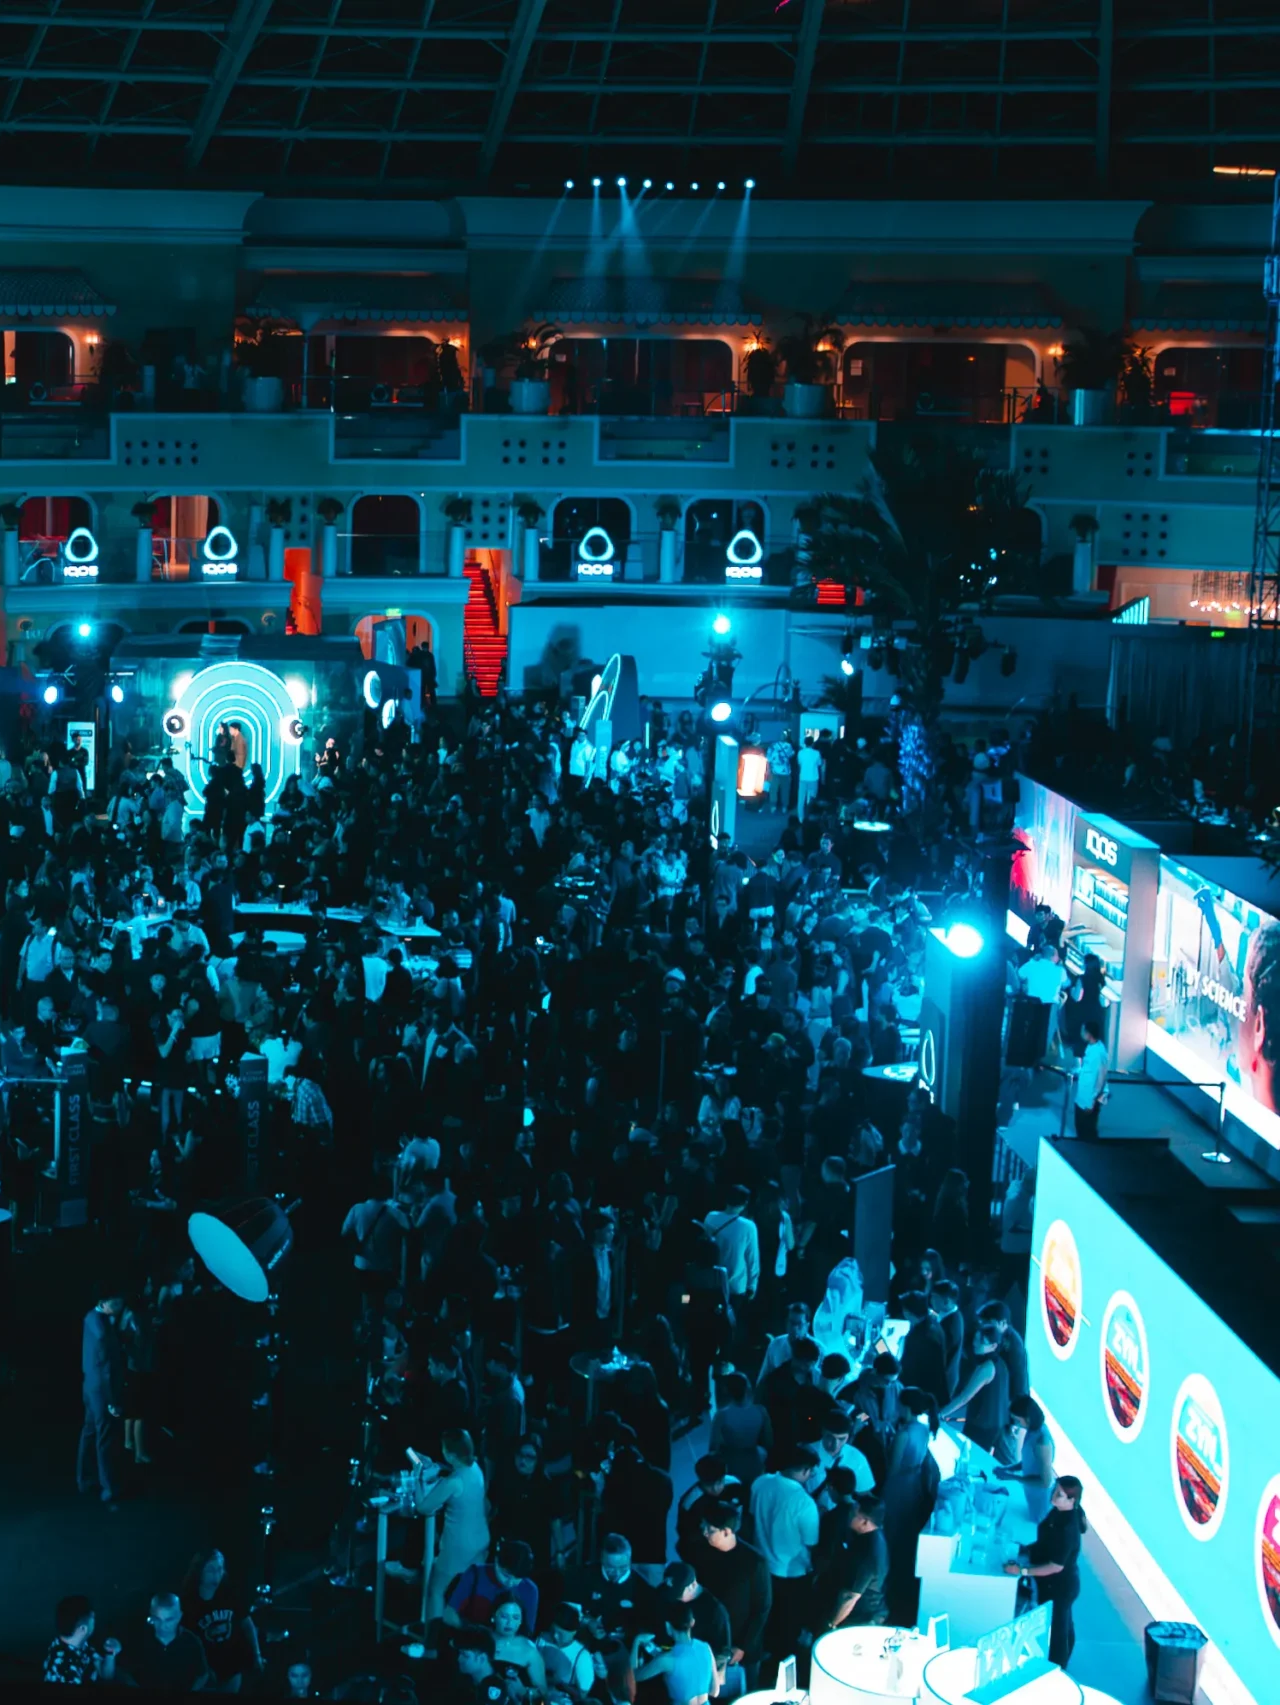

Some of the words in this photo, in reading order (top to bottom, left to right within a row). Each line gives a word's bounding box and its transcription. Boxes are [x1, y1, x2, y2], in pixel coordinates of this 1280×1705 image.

[577, 564, 614, 576] IQOS
[1085, 828, 1118, 866] IQOS
[1201, 976, 1247, 1022] SCIENCE
[1185, 1405, 1218, 1465] ZYN
